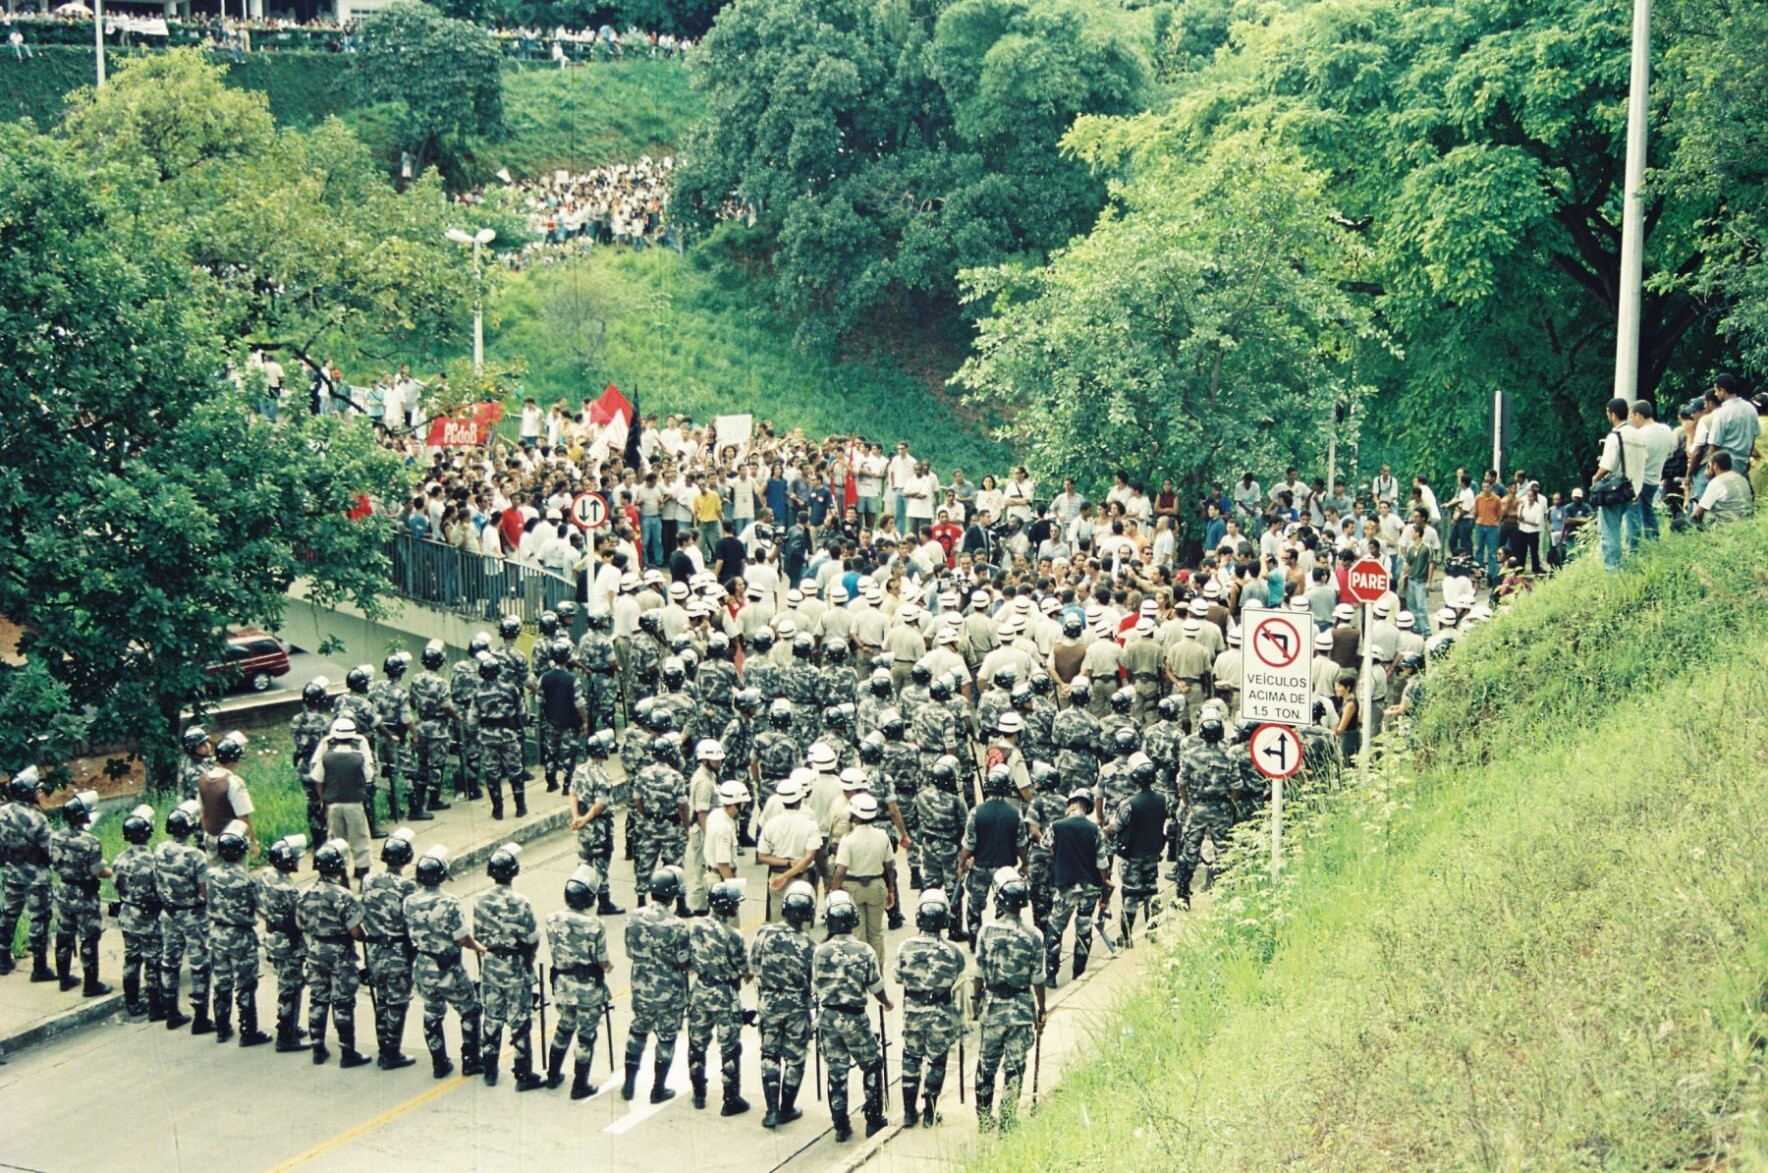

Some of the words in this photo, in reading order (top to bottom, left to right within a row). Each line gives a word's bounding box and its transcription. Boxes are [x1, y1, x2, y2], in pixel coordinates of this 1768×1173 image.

[444, 422, 478, 444] PCdoB
[1352, 571, 1386, 590] PARE
[1247, 672, 1307, 688] VEÍCULOS
[1249, 689, 1287, 702] ACIMA
[1290, 693, 1306, 704] DE
[1275, 707, 1302, 719] TON.
